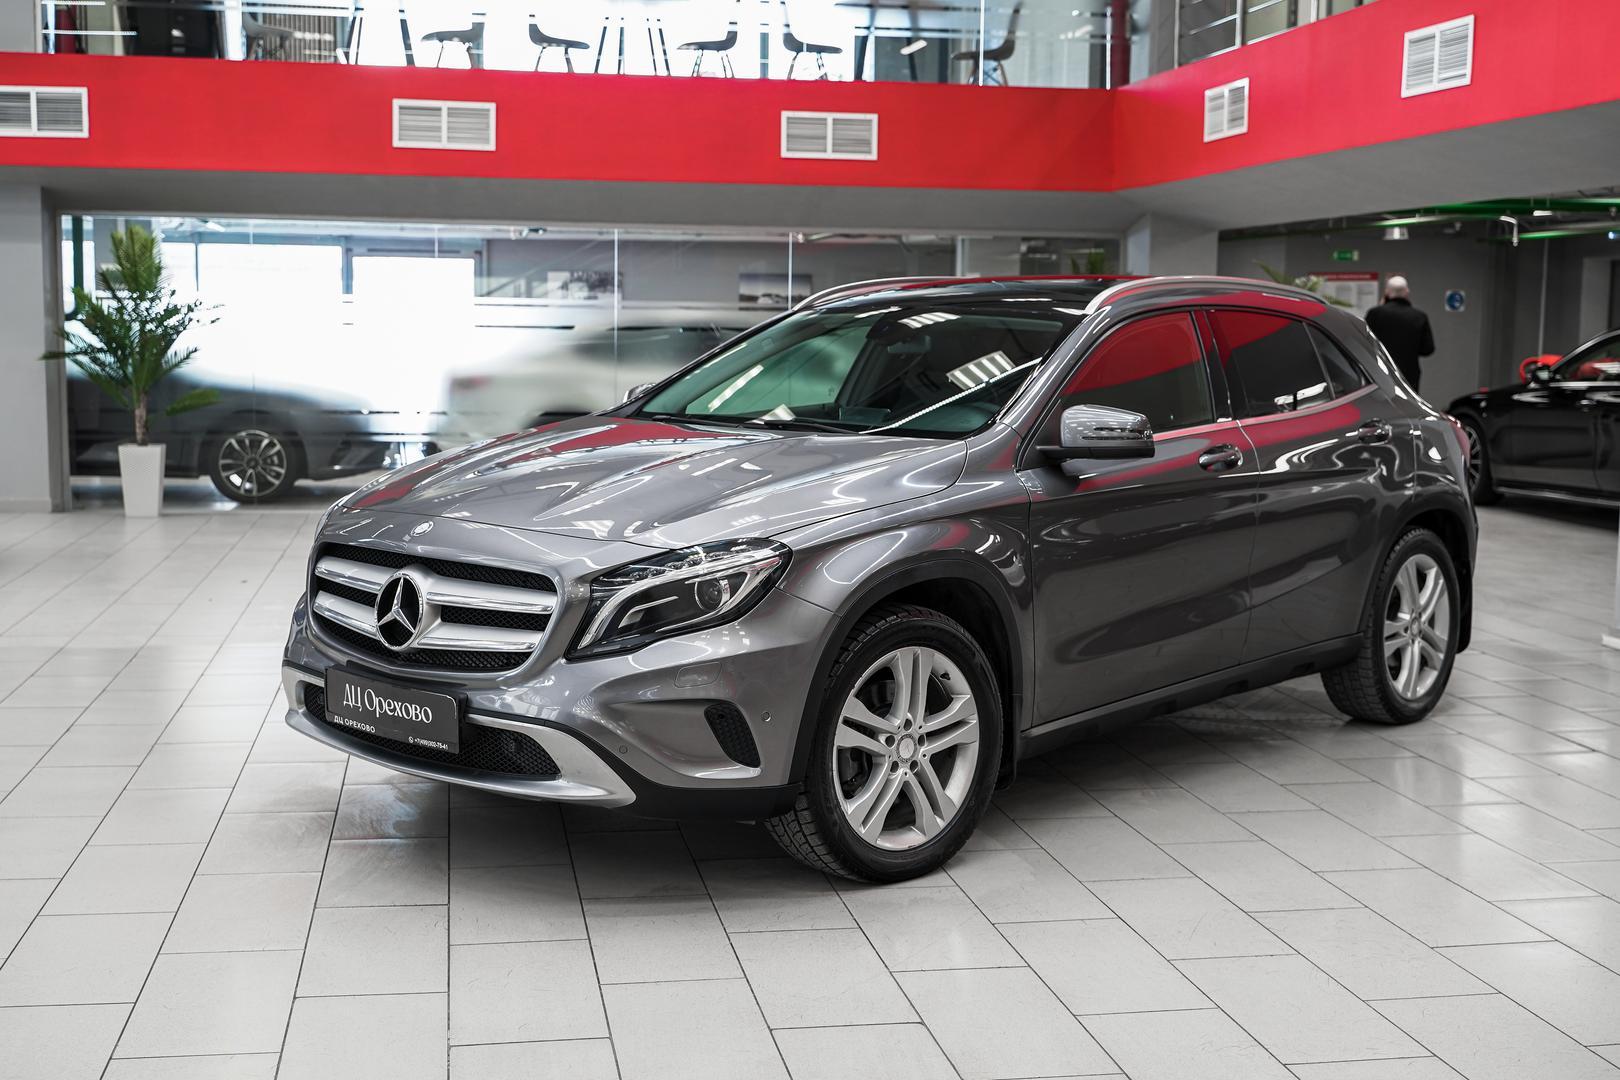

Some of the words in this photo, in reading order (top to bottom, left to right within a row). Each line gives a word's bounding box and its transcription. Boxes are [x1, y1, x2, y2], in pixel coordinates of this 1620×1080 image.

[343, 683, 362, 712] ДЦ
[364, 689, 432, 724] Орехово
[334, 715, 344, 725] ДЦ
[344, 718, 375, 733] ОРЕХОВО
